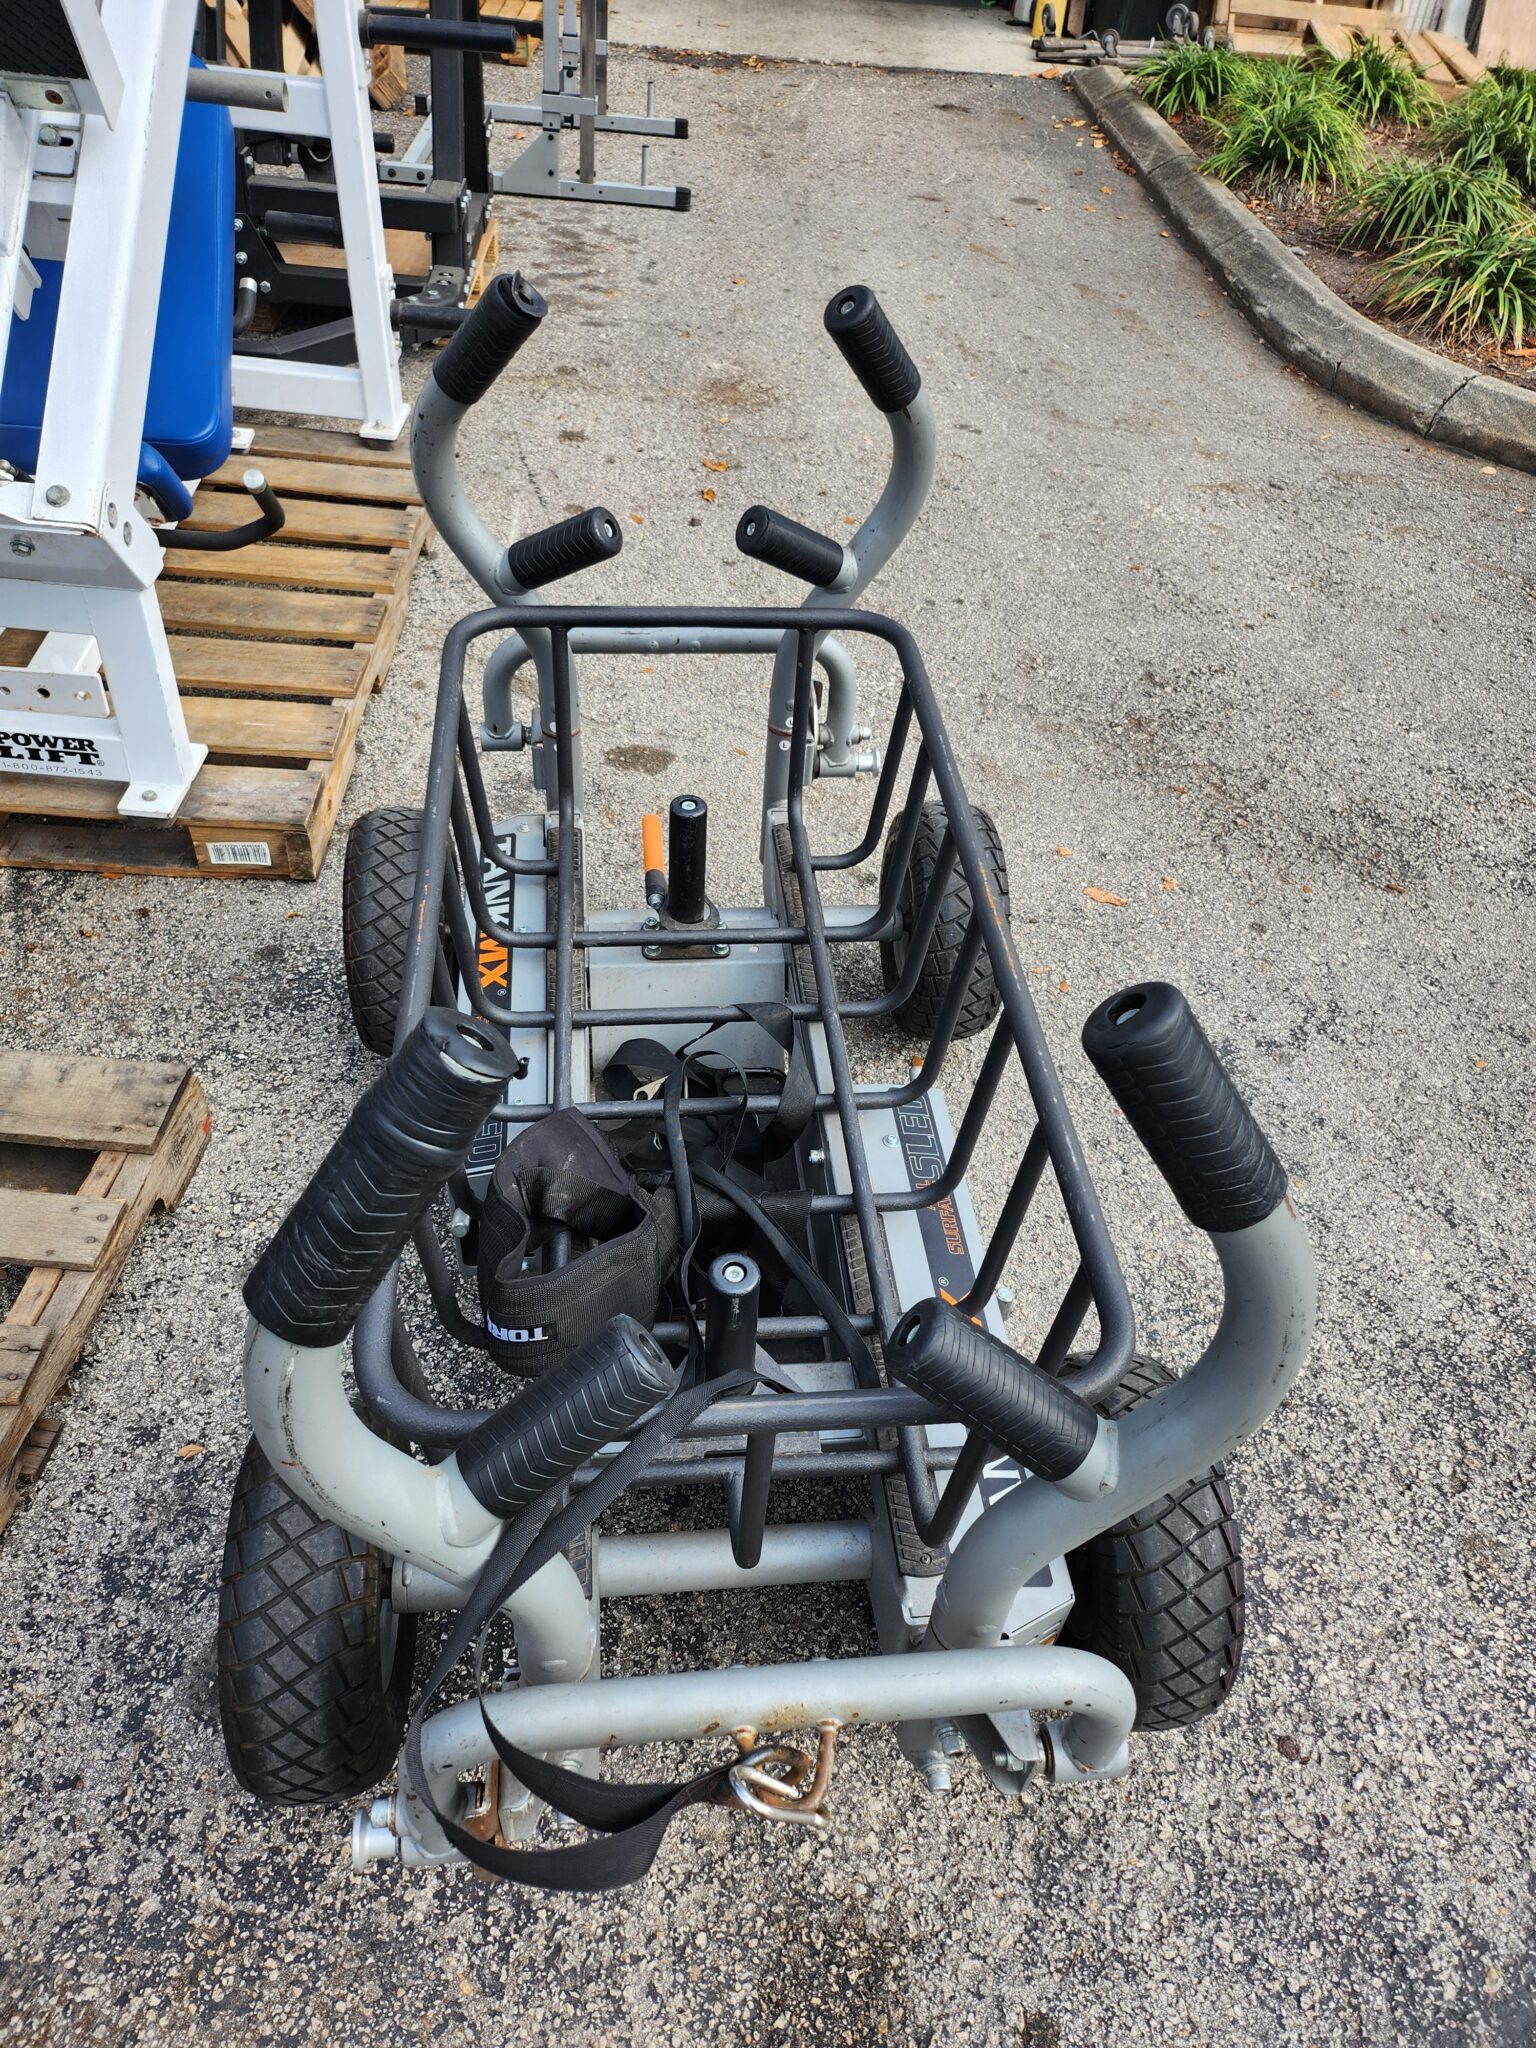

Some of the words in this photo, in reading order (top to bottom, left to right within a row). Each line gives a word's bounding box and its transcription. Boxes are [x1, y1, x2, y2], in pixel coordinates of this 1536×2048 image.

[0, 745, 100, 766] LIFT
[2, 761, 103, 777] 1-800-872-1543
[486, 1309, 549, 1342] TOR
